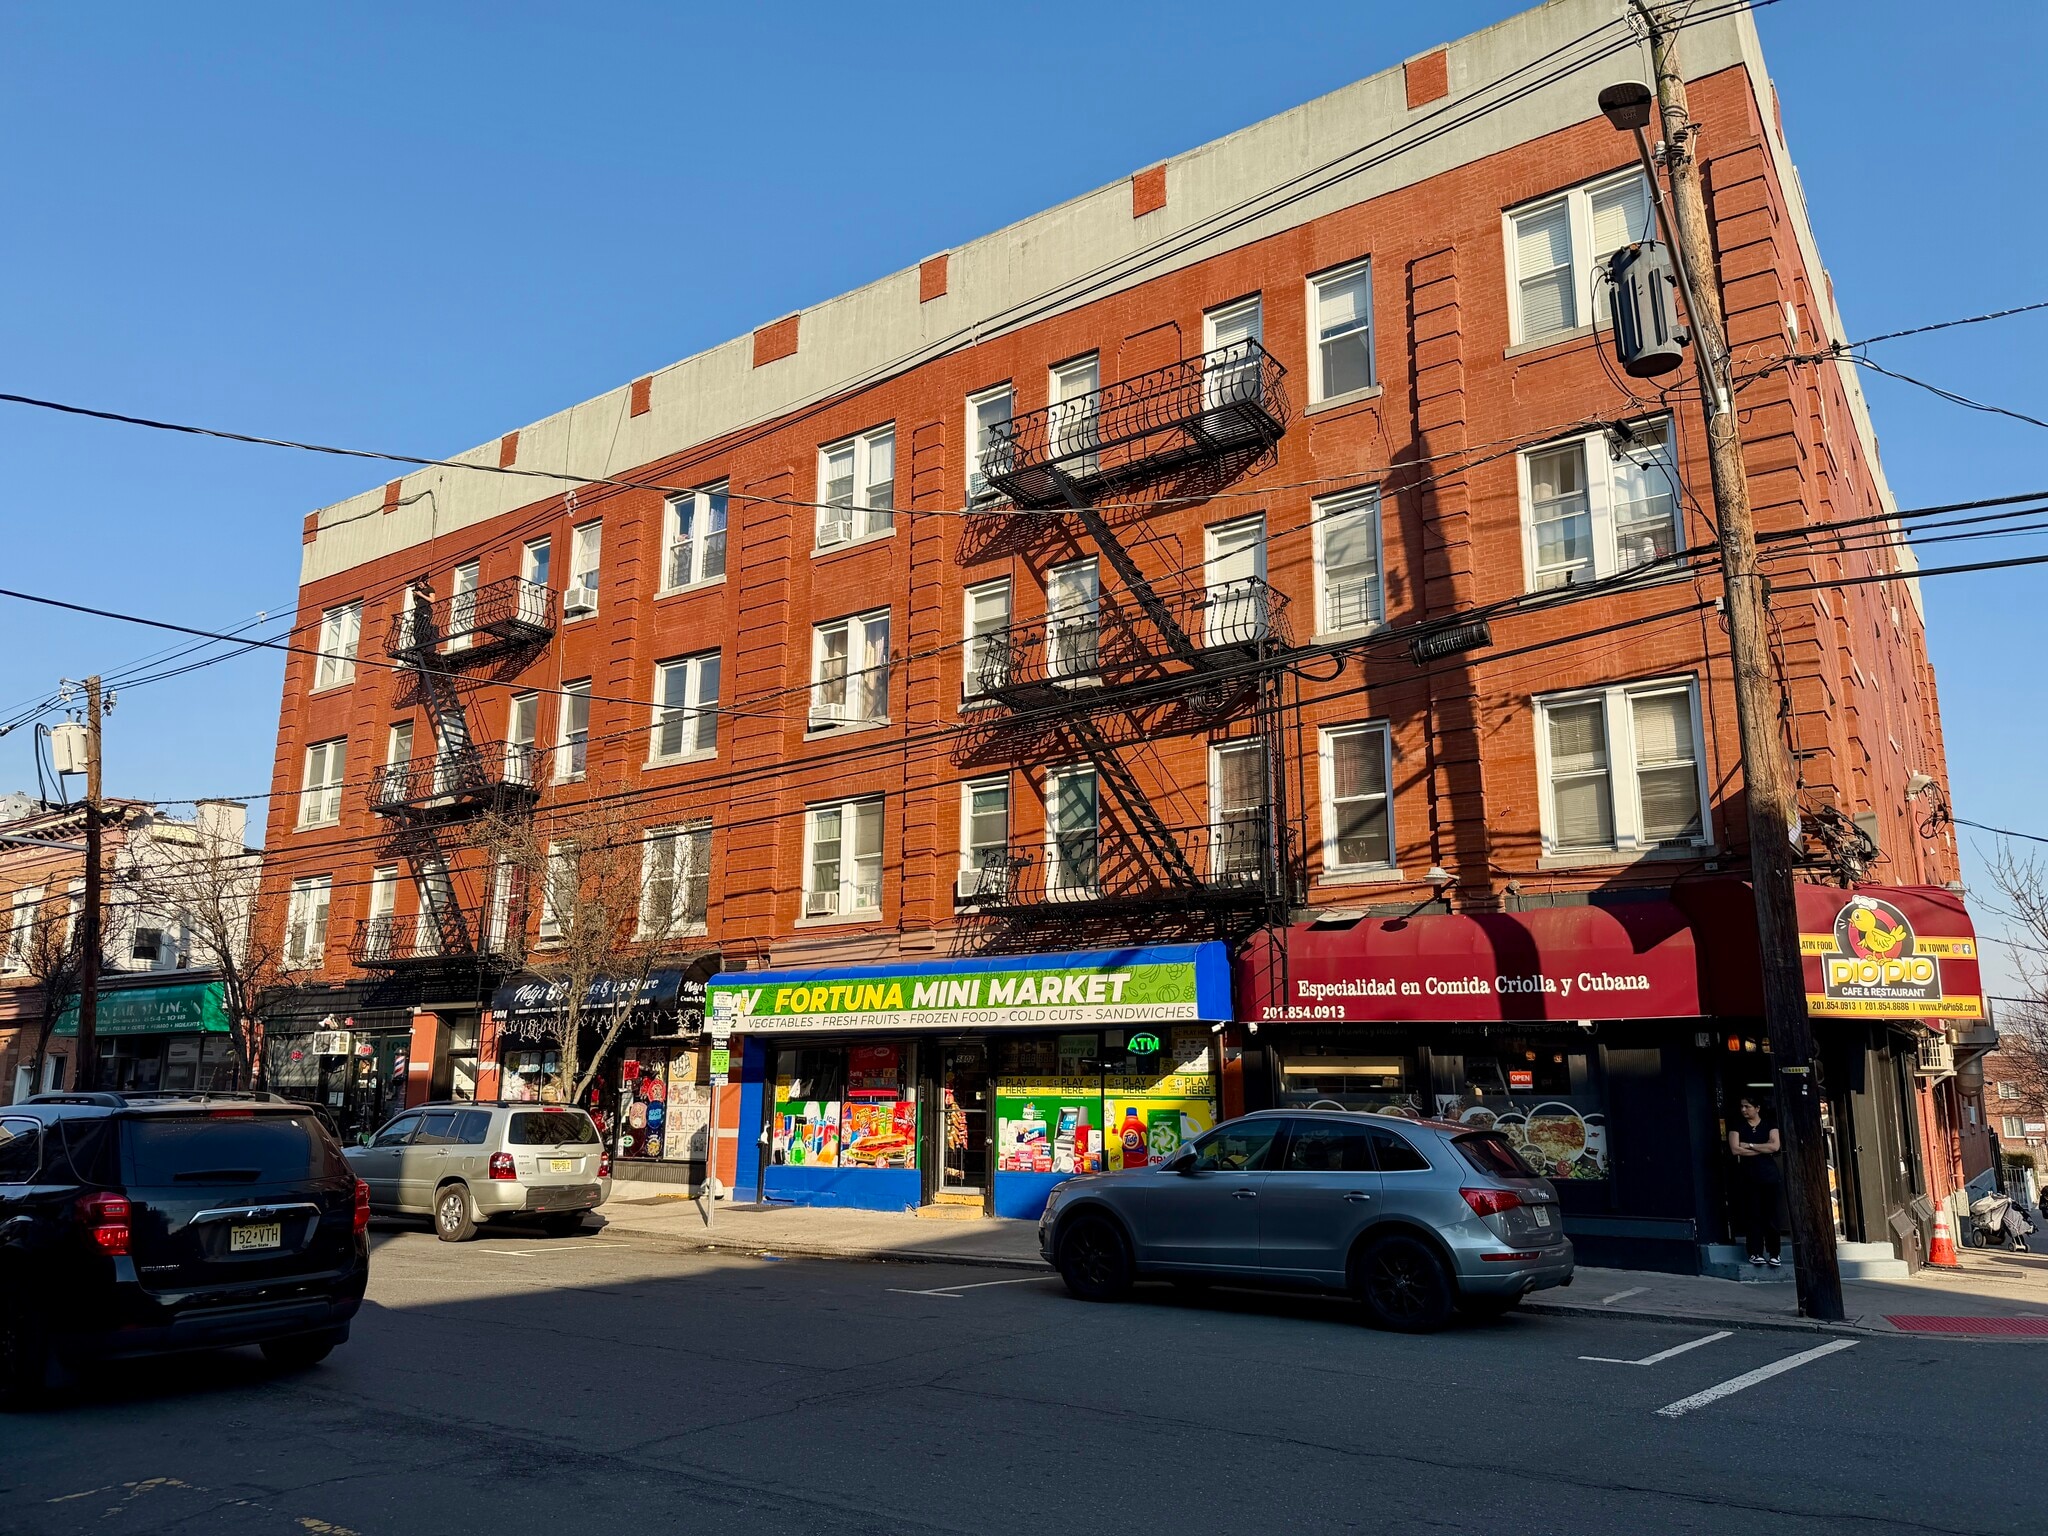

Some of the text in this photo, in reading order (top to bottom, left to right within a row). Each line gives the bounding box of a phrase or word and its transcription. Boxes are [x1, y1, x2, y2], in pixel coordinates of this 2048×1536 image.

[1800, 940, 1833, 950] ATIN FOOD
[1920, 943, 1950, 953] IN TOWN!
[1297, 972, 1650, 1000] Especialidad en Comida Criolla y Cubana
[774, 983, 904, 1013] FORTUNA
[911, 980, 981, 1008] MINI
[988, 973, 1131, 1006] MARKET
[1842, 987, 1925, 997] CAFE & RESTAURANT
[1812, 1001, 1856, 1010] 201.854.0913
[1262, 1005, 1345, 1019] 201.854.0913
[748, 1016, 814, 1029] VEGETABLES
[823, 1015, 857, 1027] FRESH
[860, 1014, 901, 1026] FRUITS
[909, 1012, 959, 1024] FROZEN
[961, 1011, 998, 1023] FOOD
[1009, 1010, 1046, 1022] COLD
[1049, 1009, 1083, 1021] CUTS
[1095, 1006, 1194, 1020] SANDWICHES
[1127, 1036, 1160, 1051] ATM
[1059, 1047, 1086, 1056] Lottery
[1005, 1078, 1028, 1086] PLAY
[1061, 1077, 1084, 1086] PLAY
[1122, 1077, 1147, 1085] PLAY
[1184, 1077, 1210, 1085] PLAY
[1511, 1073, 1532, 1082] OPEN
[1005, 1086, 1028, 1094] HERE
[1061, 1086, 1084, 1094] HERE
[1122, 1085, 1147, 1094] HERE
[1185, 1085, 1210, 1095] HERE
[826, 1115, 837, 1125] ICE
[1125, 1133, 1138, 1145] Tide
[232, 1228, 278, 1245] T52 VTH
